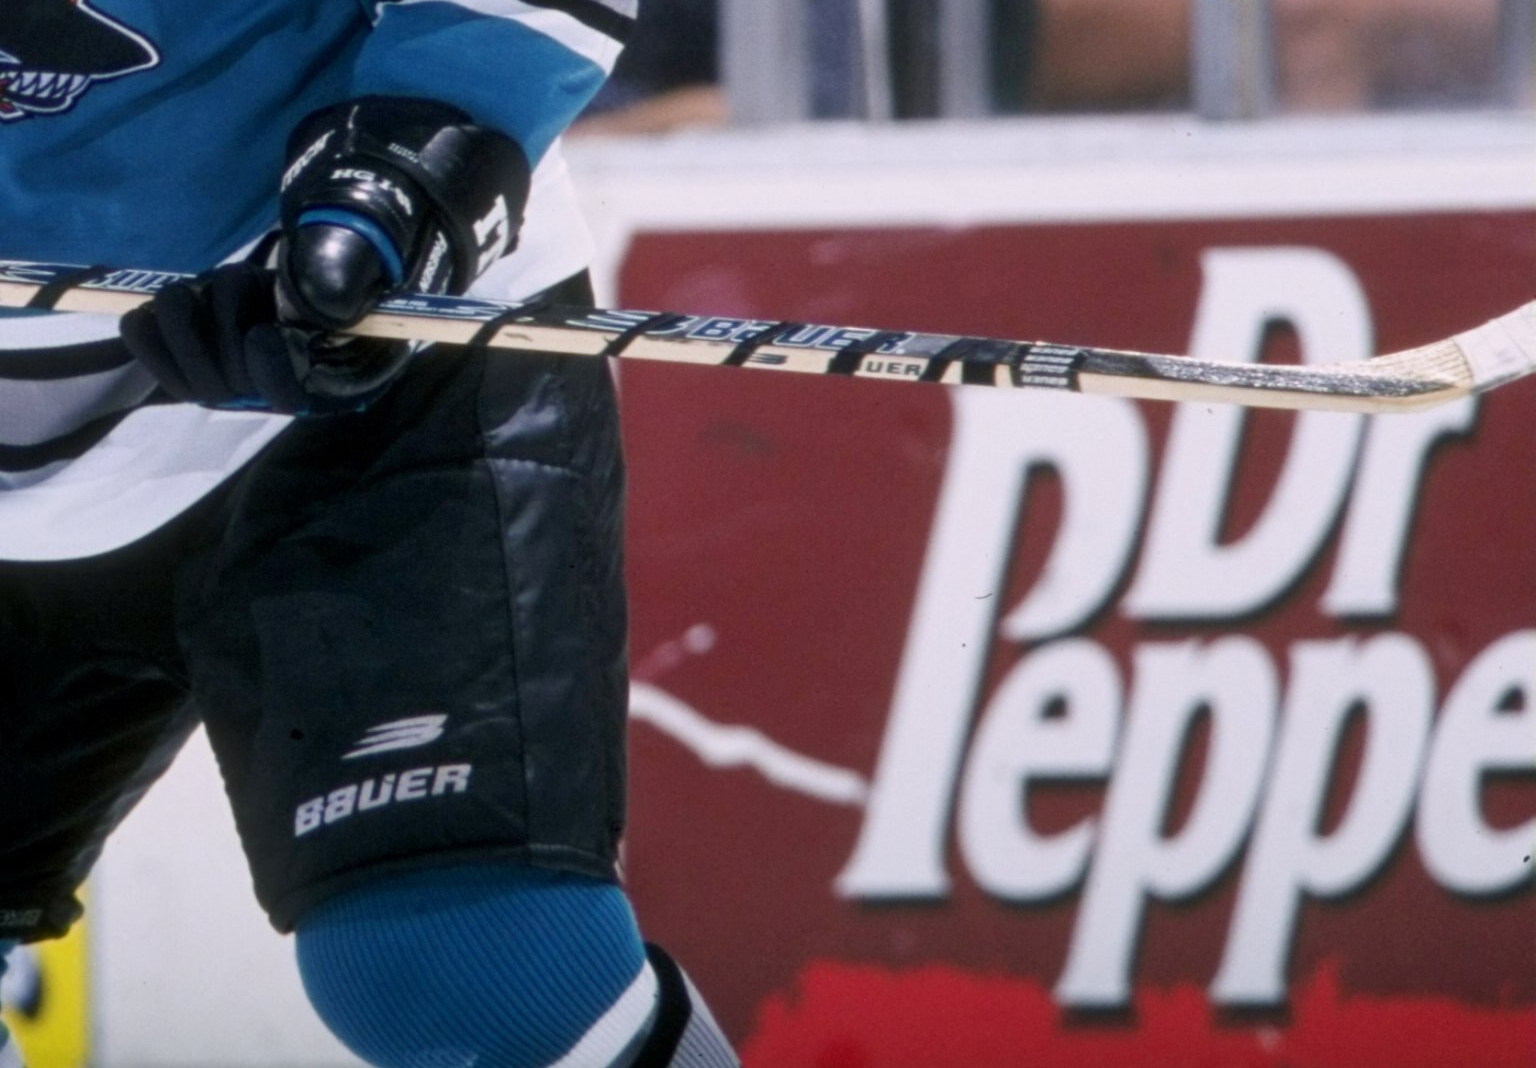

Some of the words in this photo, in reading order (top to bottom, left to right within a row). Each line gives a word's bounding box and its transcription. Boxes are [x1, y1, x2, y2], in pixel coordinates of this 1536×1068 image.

[865, 360, 922, 377] UER
[1118, 243, 1479, 618] Dr
[294, 762, 473, 837] BAUER
[832, 378, 1536, 1010] Peppe
